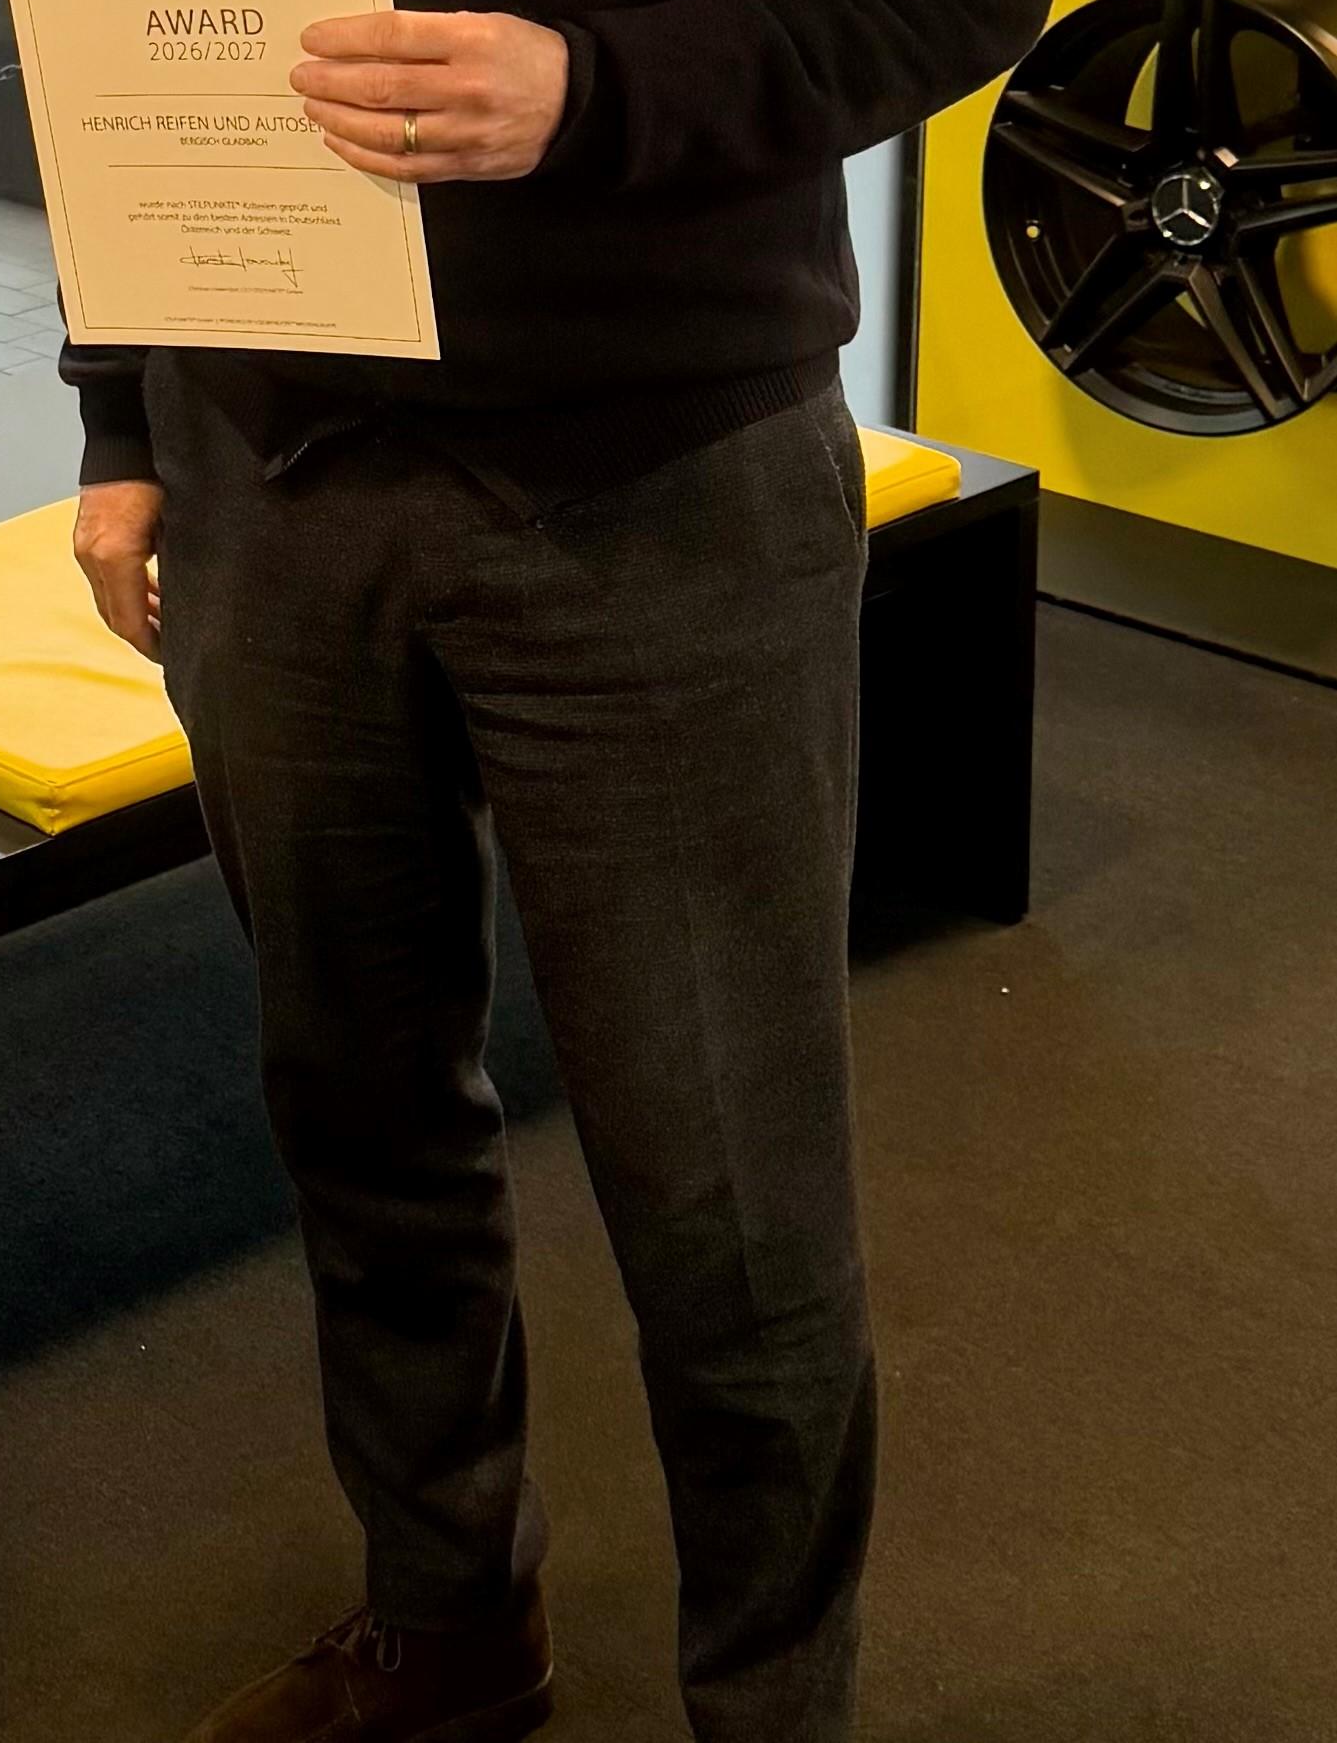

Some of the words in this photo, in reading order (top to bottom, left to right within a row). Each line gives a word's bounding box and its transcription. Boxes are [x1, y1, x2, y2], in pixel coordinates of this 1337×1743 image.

[146, 9, 264, 36] AWARD
[148, 41, 266, 61] 2026/2027
[81, 115, 152, 132] HENRICH
[157, 115, 209, 131] REIFEN
[214, 115, 250, 131] UND
